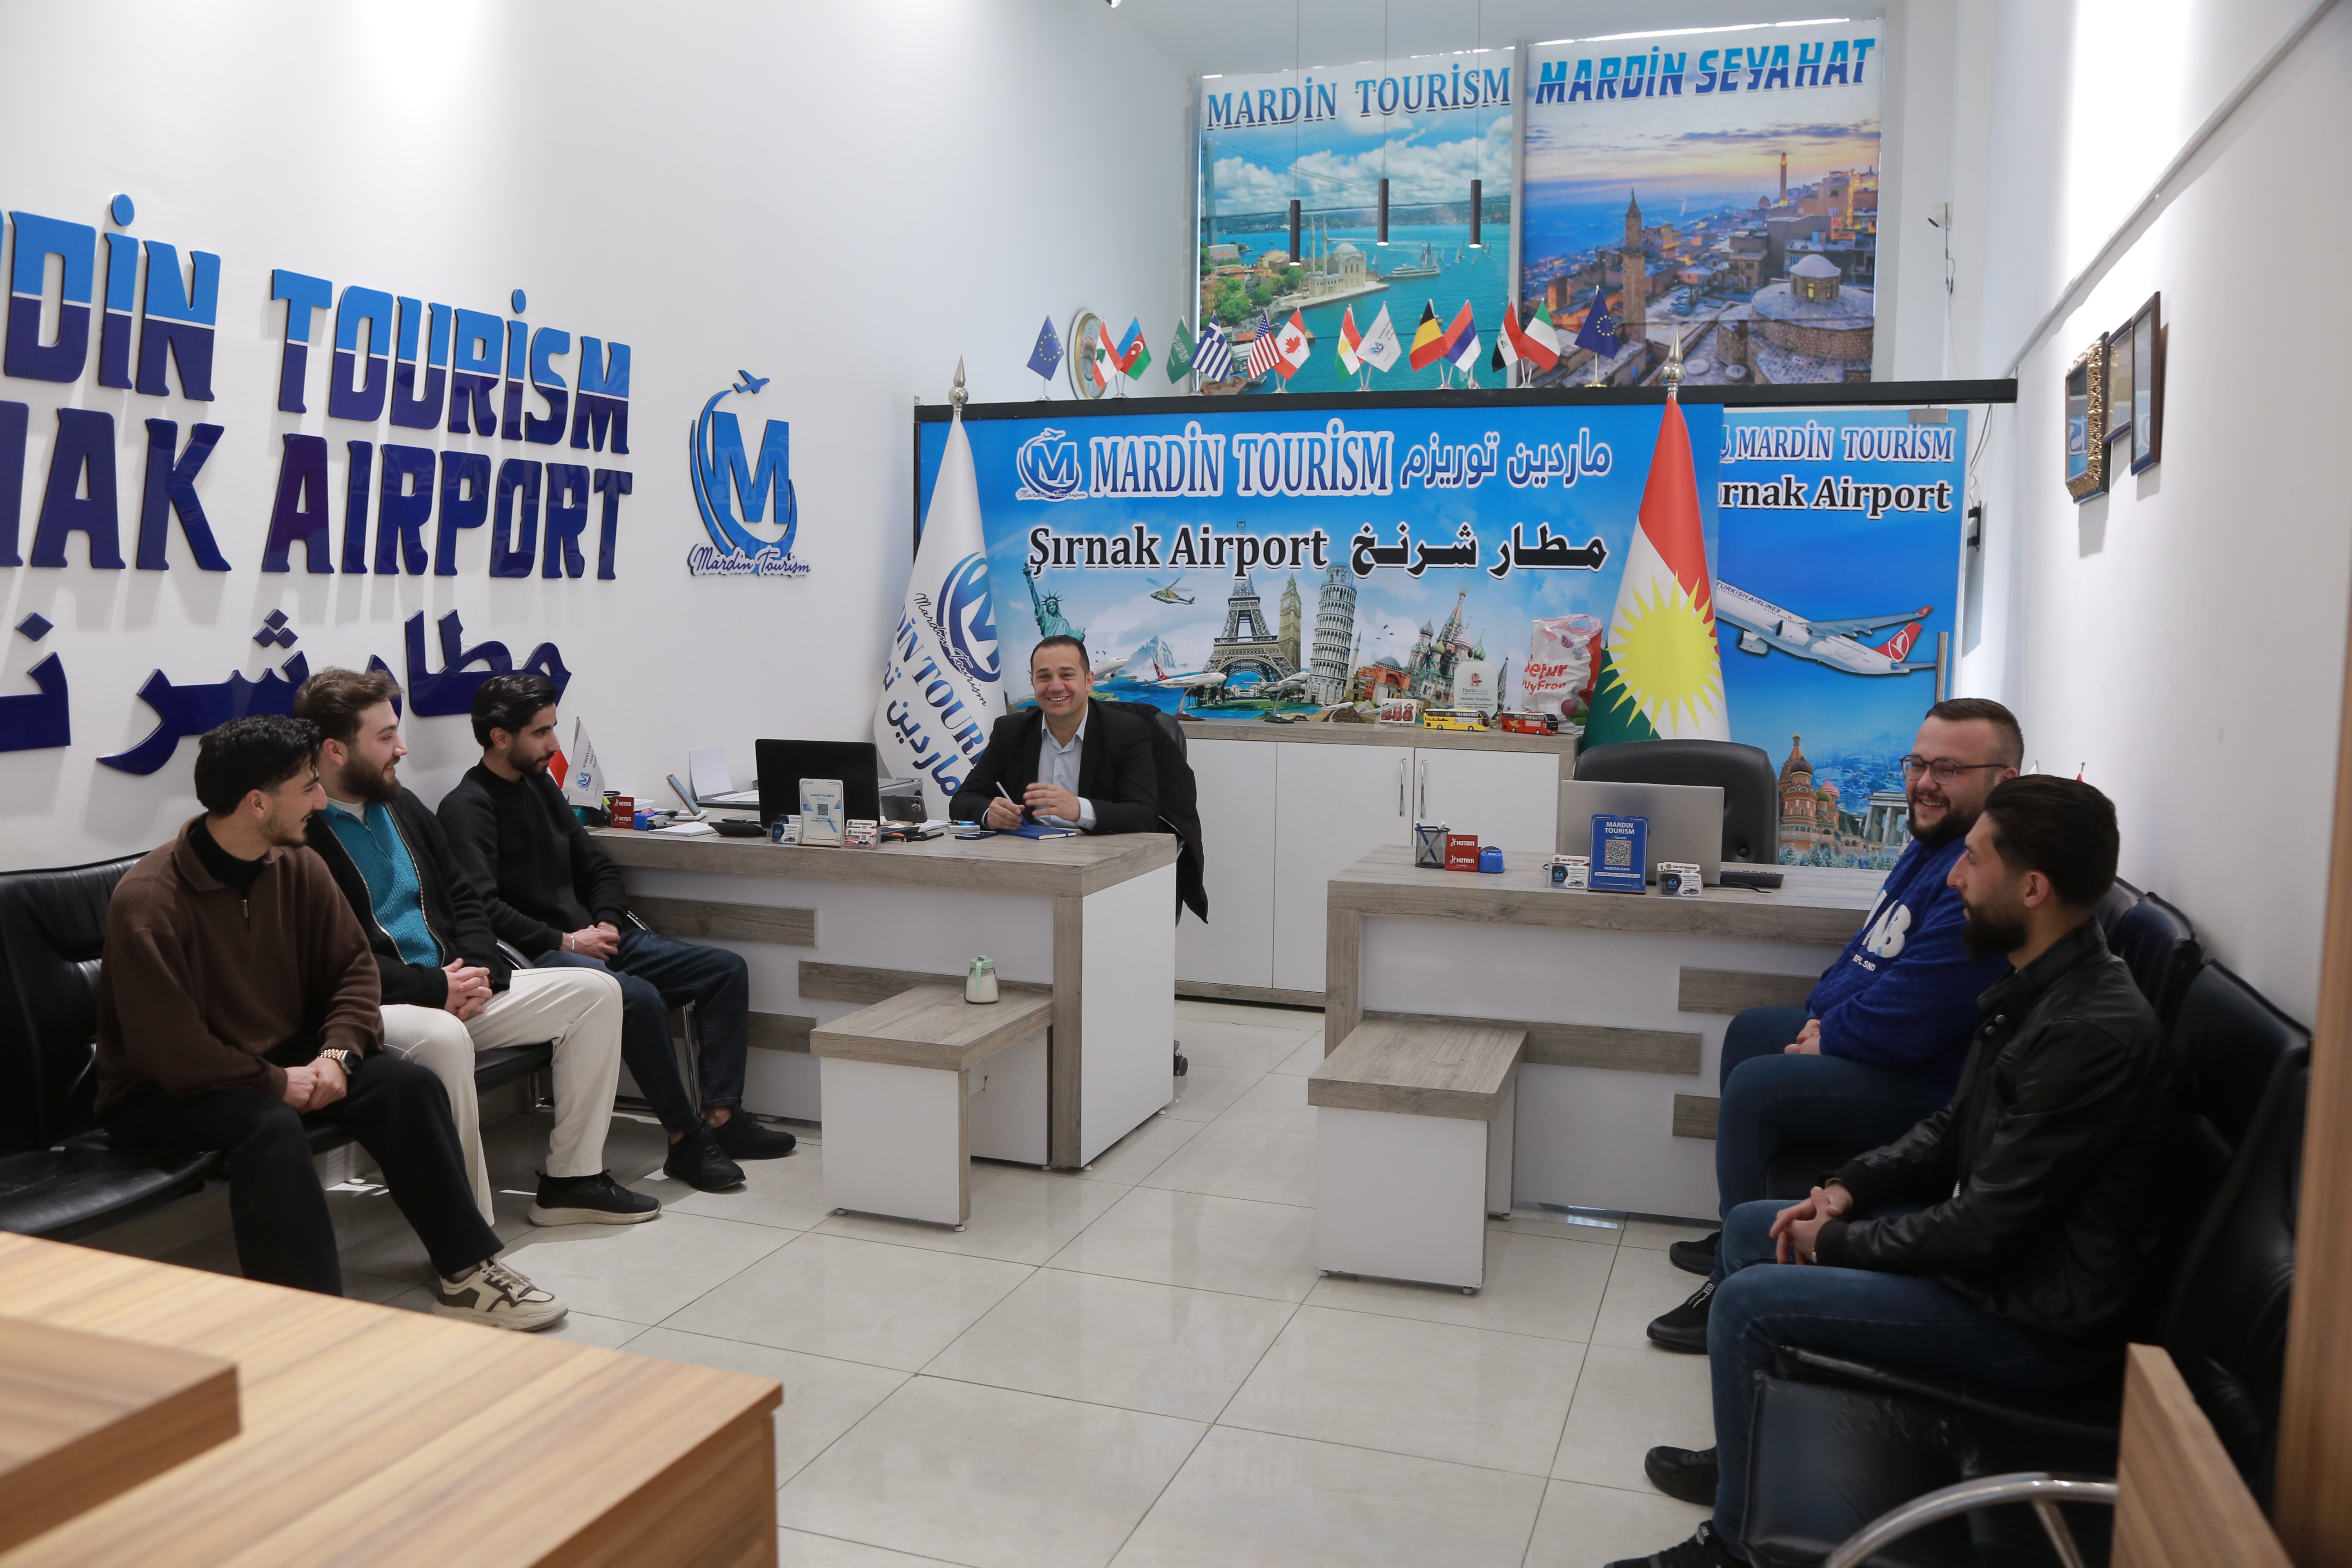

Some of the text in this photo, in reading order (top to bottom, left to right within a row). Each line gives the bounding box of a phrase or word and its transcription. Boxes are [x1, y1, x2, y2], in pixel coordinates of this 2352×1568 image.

[1207, 63, 1511, 128] MARDİN TOURİSM
[1535, 39, 1875, 105] MARDİN SEYAHAT
[0, 194, 631, 454] DİN TOURİSM
[1094, 421, 1389, 493] MARDİN TOURİSM
[1401, 428, 1610, 486] ماردين توريزم
[1737, 422, 1953, 460] MARDİN TOURİSM
[262, 432, 633, 580] AIRPORT
[1018, 489, 1086, 498] Mardin Tourism
[1722, 477, 1951, 516] rnak Airport
[693, 547, 811, 574] Mardin Tourism
[1029, 525, 1328, 577] Şırnak Airport
[1352, 523, 1607, 577] مطار شرنخ
[1717, 582, 1782, 613] TURKISH AIRLINES
[914, 592, 987, 707] Mardin Tourism
[911, 655, 987, 768] TOUR
[1537, 680, 1566, 690] Free
